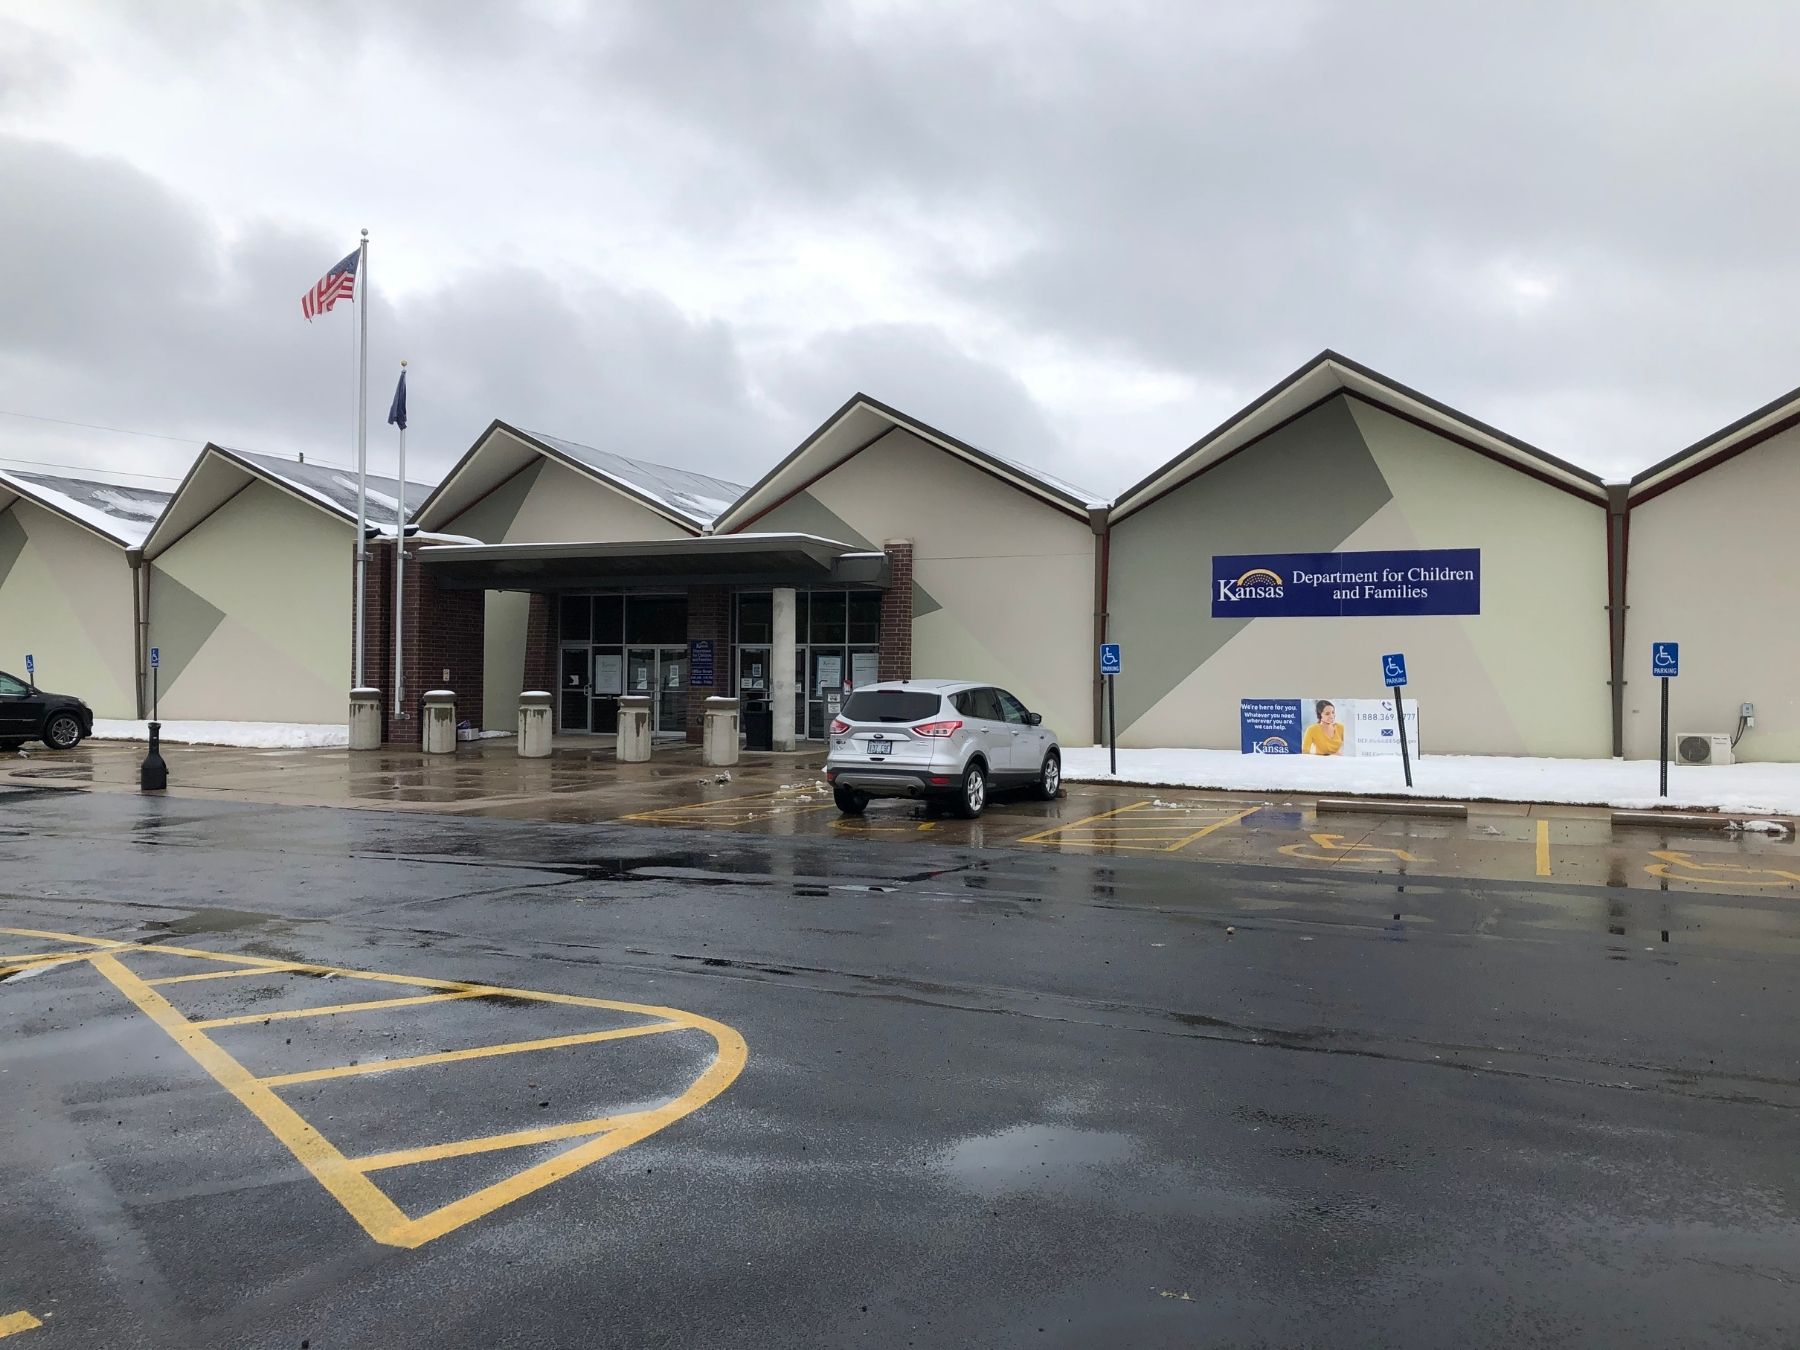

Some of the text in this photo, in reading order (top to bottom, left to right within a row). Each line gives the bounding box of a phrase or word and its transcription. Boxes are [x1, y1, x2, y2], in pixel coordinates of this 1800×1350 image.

[1292, 567, 1474, 587] Department for Children
[1217, 579, 1284, 602] Kansas
[1333, 584, 1428, 599] and Families
[1252, 741, 1289, 753] Kansas
